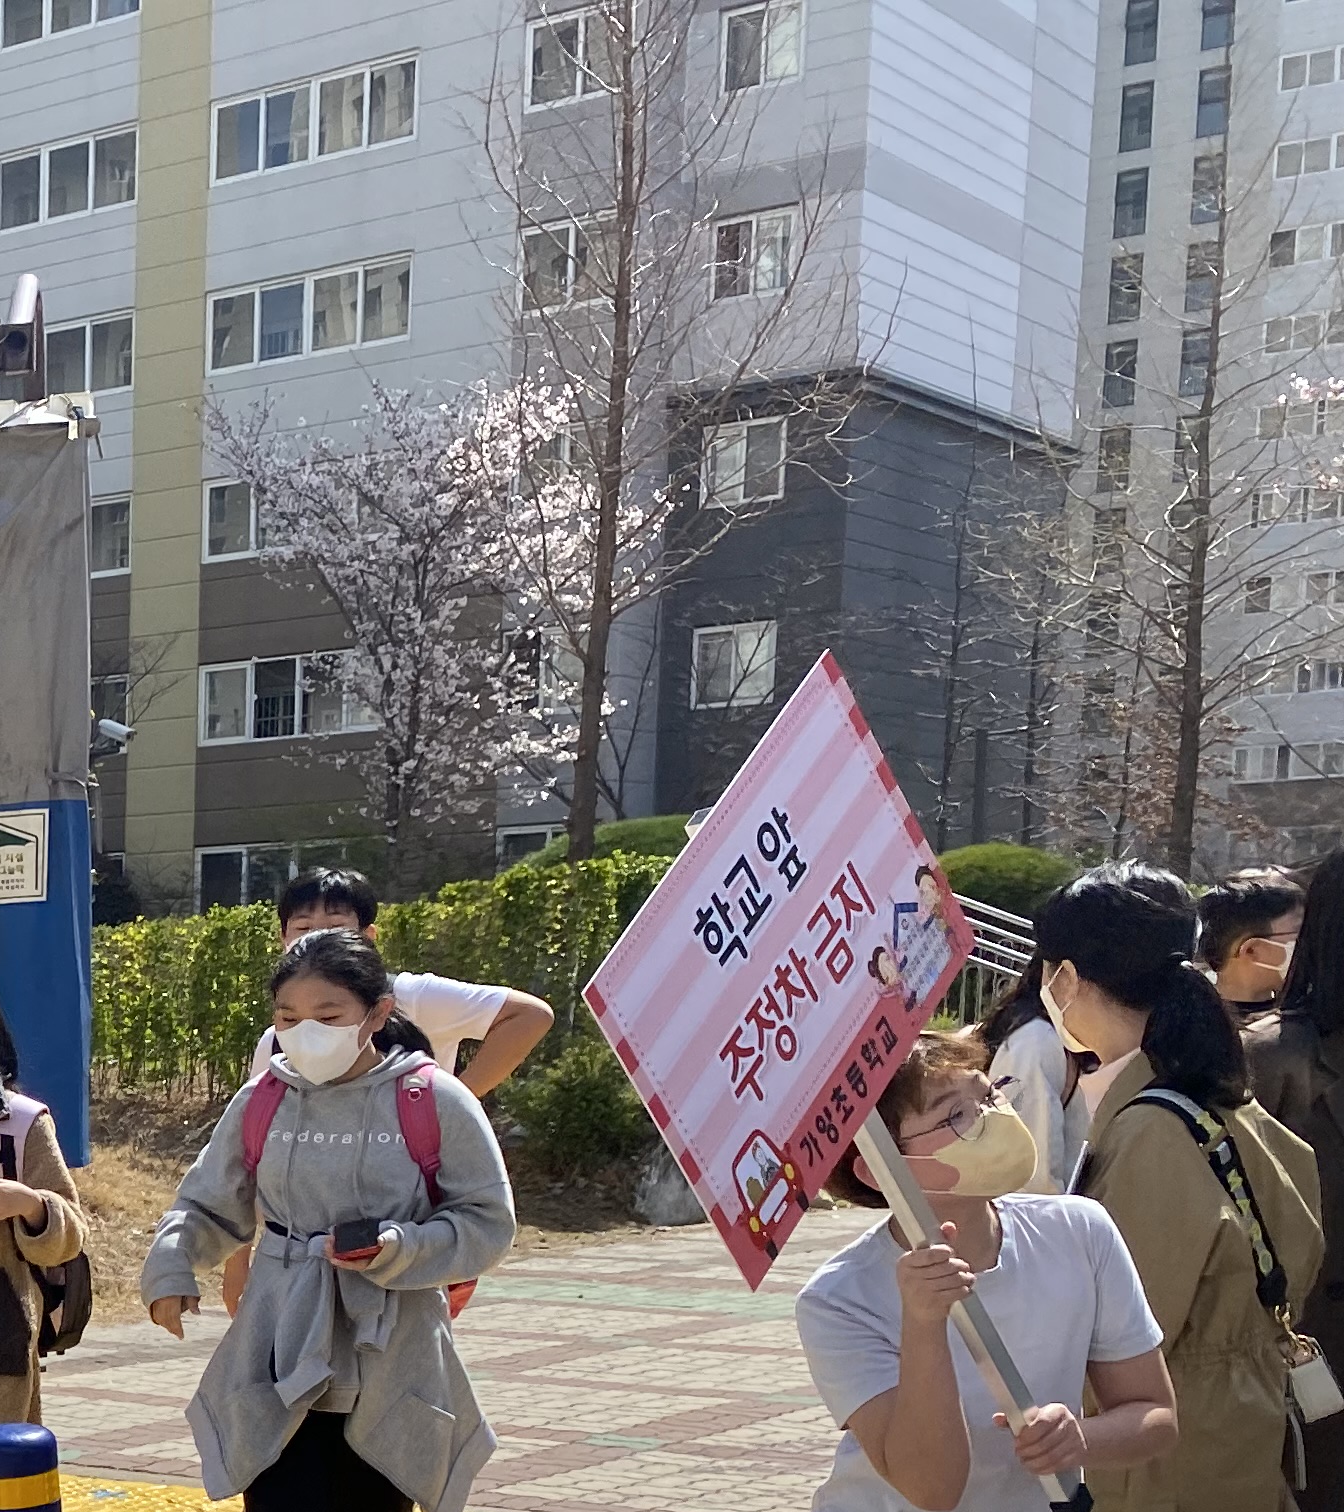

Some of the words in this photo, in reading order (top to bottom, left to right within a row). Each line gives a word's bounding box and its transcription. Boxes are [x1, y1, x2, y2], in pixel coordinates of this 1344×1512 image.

[693, 854, 772, 967] 학교
[756, 807, 808, 893] 앞
[719, 948, 818, 1101] 주정차
[807, 860, 876, 984] 금지
[799, 1016, 899, 1167] 가양초등학교
